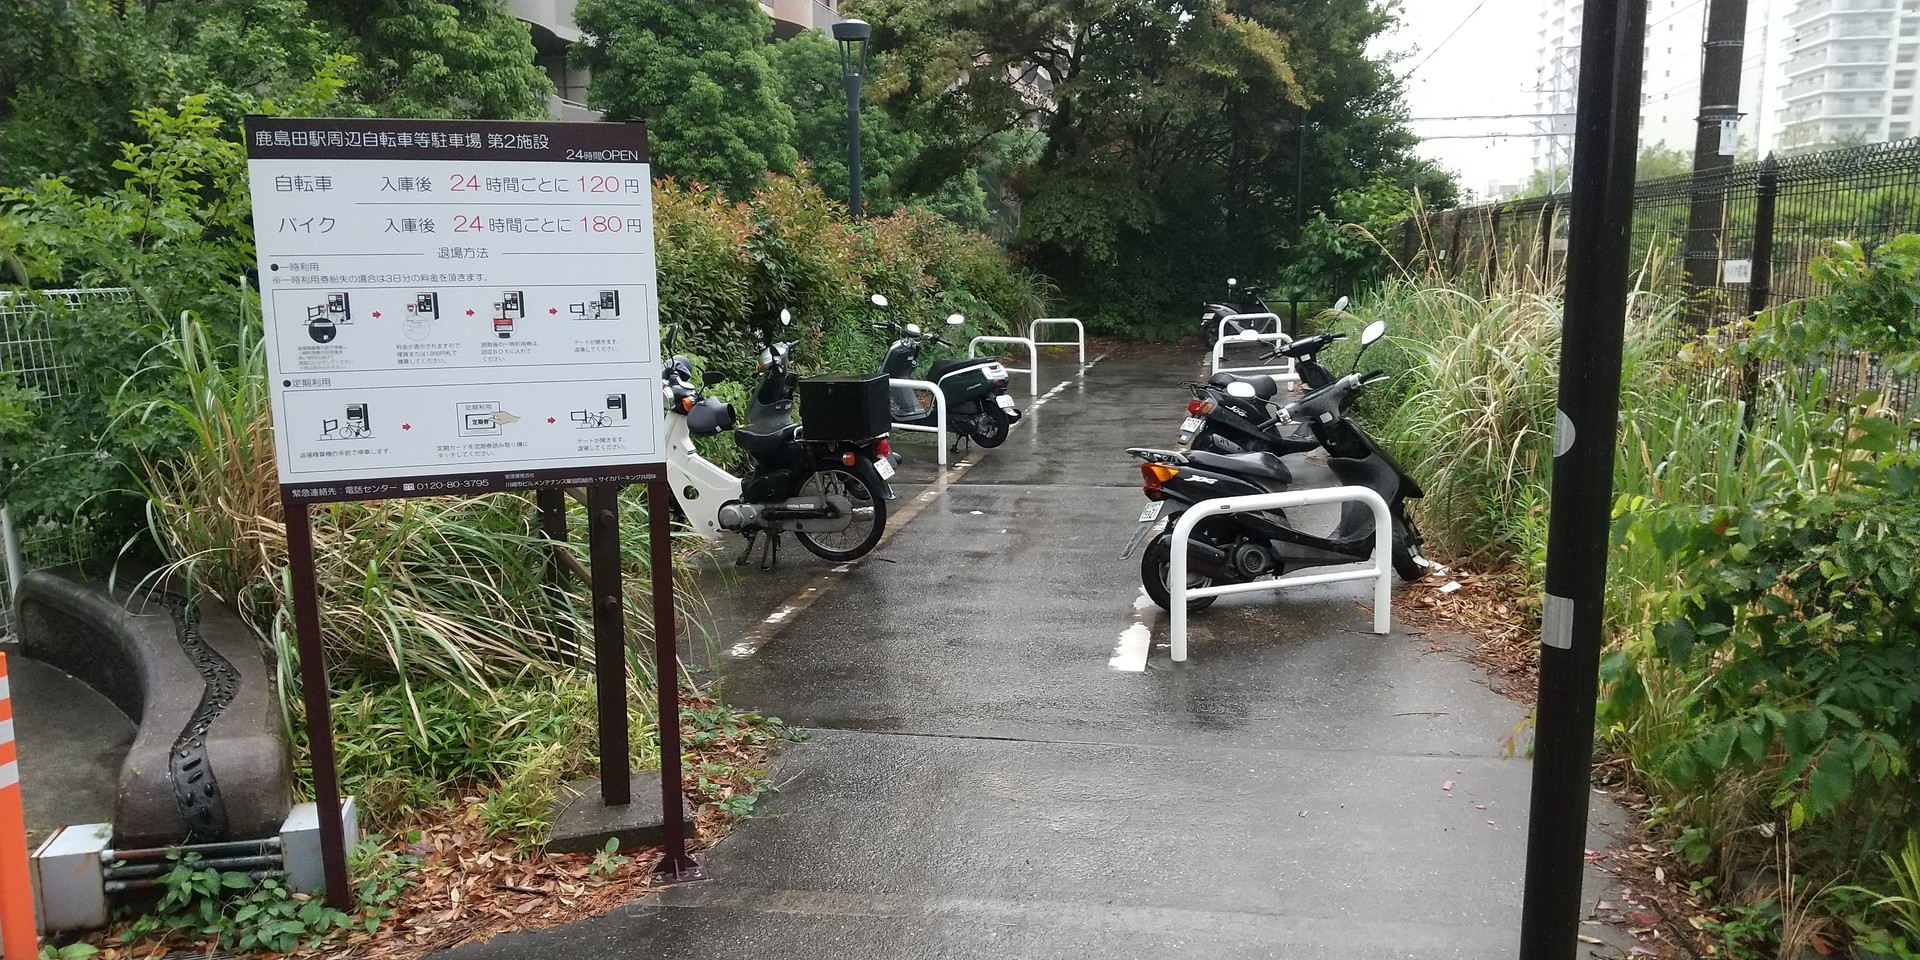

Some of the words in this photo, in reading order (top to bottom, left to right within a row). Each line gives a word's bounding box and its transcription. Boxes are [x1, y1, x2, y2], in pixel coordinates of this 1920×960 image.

[255, 130, 482, 149] 鹿島田駅周辺自転車等駐車場
[487, 132, 550, 150] 第2施設
[566, 149, 639, 161] 24時間OPEN
[275, 175, 333, 192] 自転車
[380, 176, 432, 192] 入庫後
[450, 174, 481, 192] 24
[485, 176, 570, 193] 時間ごとに
[577, 175, 620, 193] 120
[624, 178, 640, 194] 円
[278, 216, 336, 234] バイク
[384, 217, 436, 234] 入庫後
[453, 215, 484, 233] 24
[488, 217, 572, 233] 時間ごとに
[580, 215, 622, 233] 180
[626, 218, 642, 233] 円
[437, 247, 490, 259] 退場方法
[416, 479, 489, 491] 0120-80-3795
